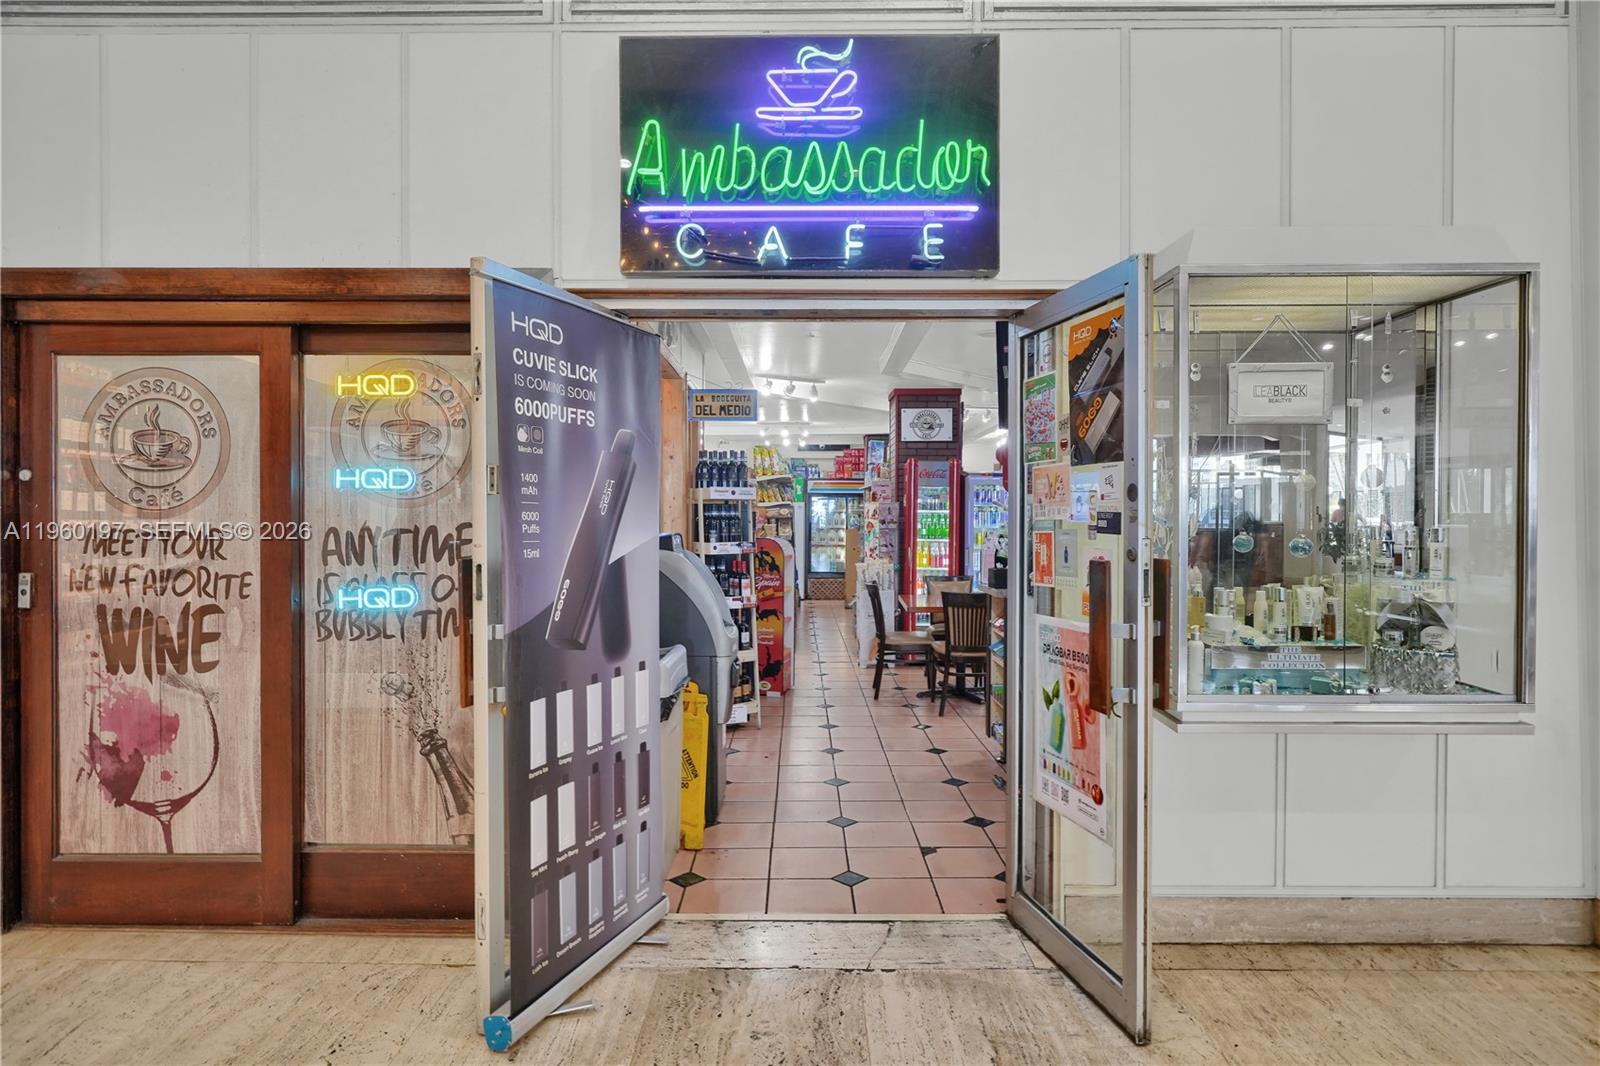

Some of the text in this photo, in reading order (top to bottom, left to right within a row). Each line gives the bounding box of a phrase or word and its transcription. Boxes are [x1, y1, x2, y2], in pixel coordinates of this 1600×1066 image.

[626, 118, 991, 198] Ambassador
[675, 222, 946, 262] CAFE
[511, 311, 564, 345] HQD
[1073, 326, 1092, 341] HQD
[512, 347, 598, 384] CUVIE SLICK
[336, 374, 416, 396] HQD
[514, 373, 597, 402] IS COMING SOON
[97, 378, 218, 439] AMBASSADORS
[695, 394, 752, 403] LA BODEGUITA
[695, 404, 752, 416] DEL MEDIO
[514, 396, 596, 428] 6000PUFFS
[532, 446, 544, 455] Coil
[335, 467, 414, 490] HQD
[520, 472, 538, 483] 1400
[128, 486, 184, 507] Café
[521, 485, 538, 495] mAh
[521, 511, 540, 521] 6000
[522, 523, 541, 534] Puffs
[83, 525, 227, 560] MEET YOUR
[523, 548, 540, 559] 15ml
[69, 563, 117, 594] NEW
[431, 573, 458, 602] O
[337, 587, 417, 609] HQD
[315, 608, 409, 644] BUBBLY
[96, 601, 225, 685] WINE
